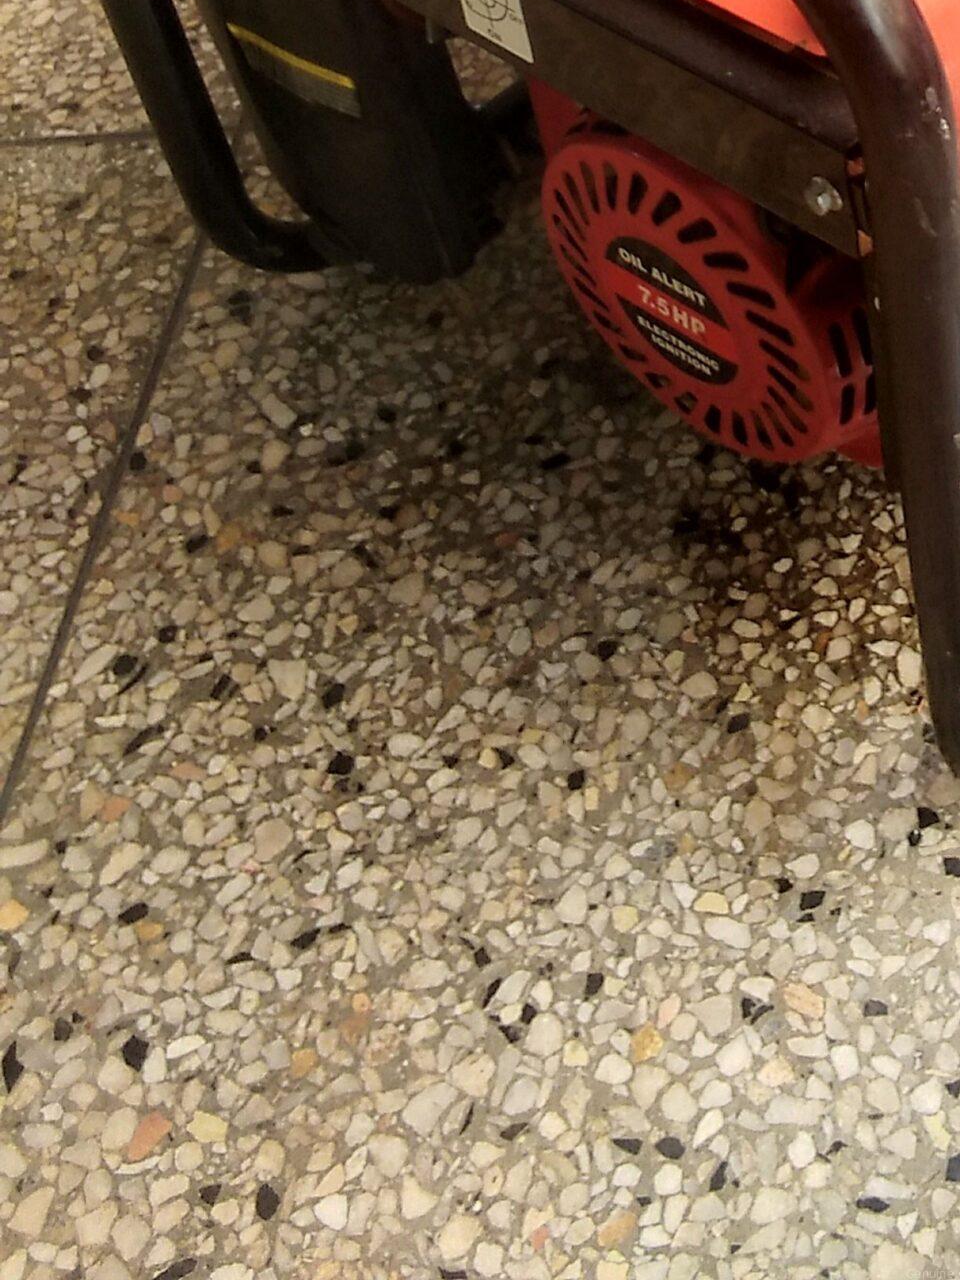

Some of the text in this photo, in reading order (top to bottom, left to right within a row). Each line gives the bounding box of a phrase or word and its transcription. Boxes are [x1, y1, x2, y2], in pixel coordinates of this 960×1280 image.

[618, 247, 706, 307] OIL ALERT
[637, 315, 720, 371] ELECTRONIC
[651, 333, 712, 376] IGNITION
